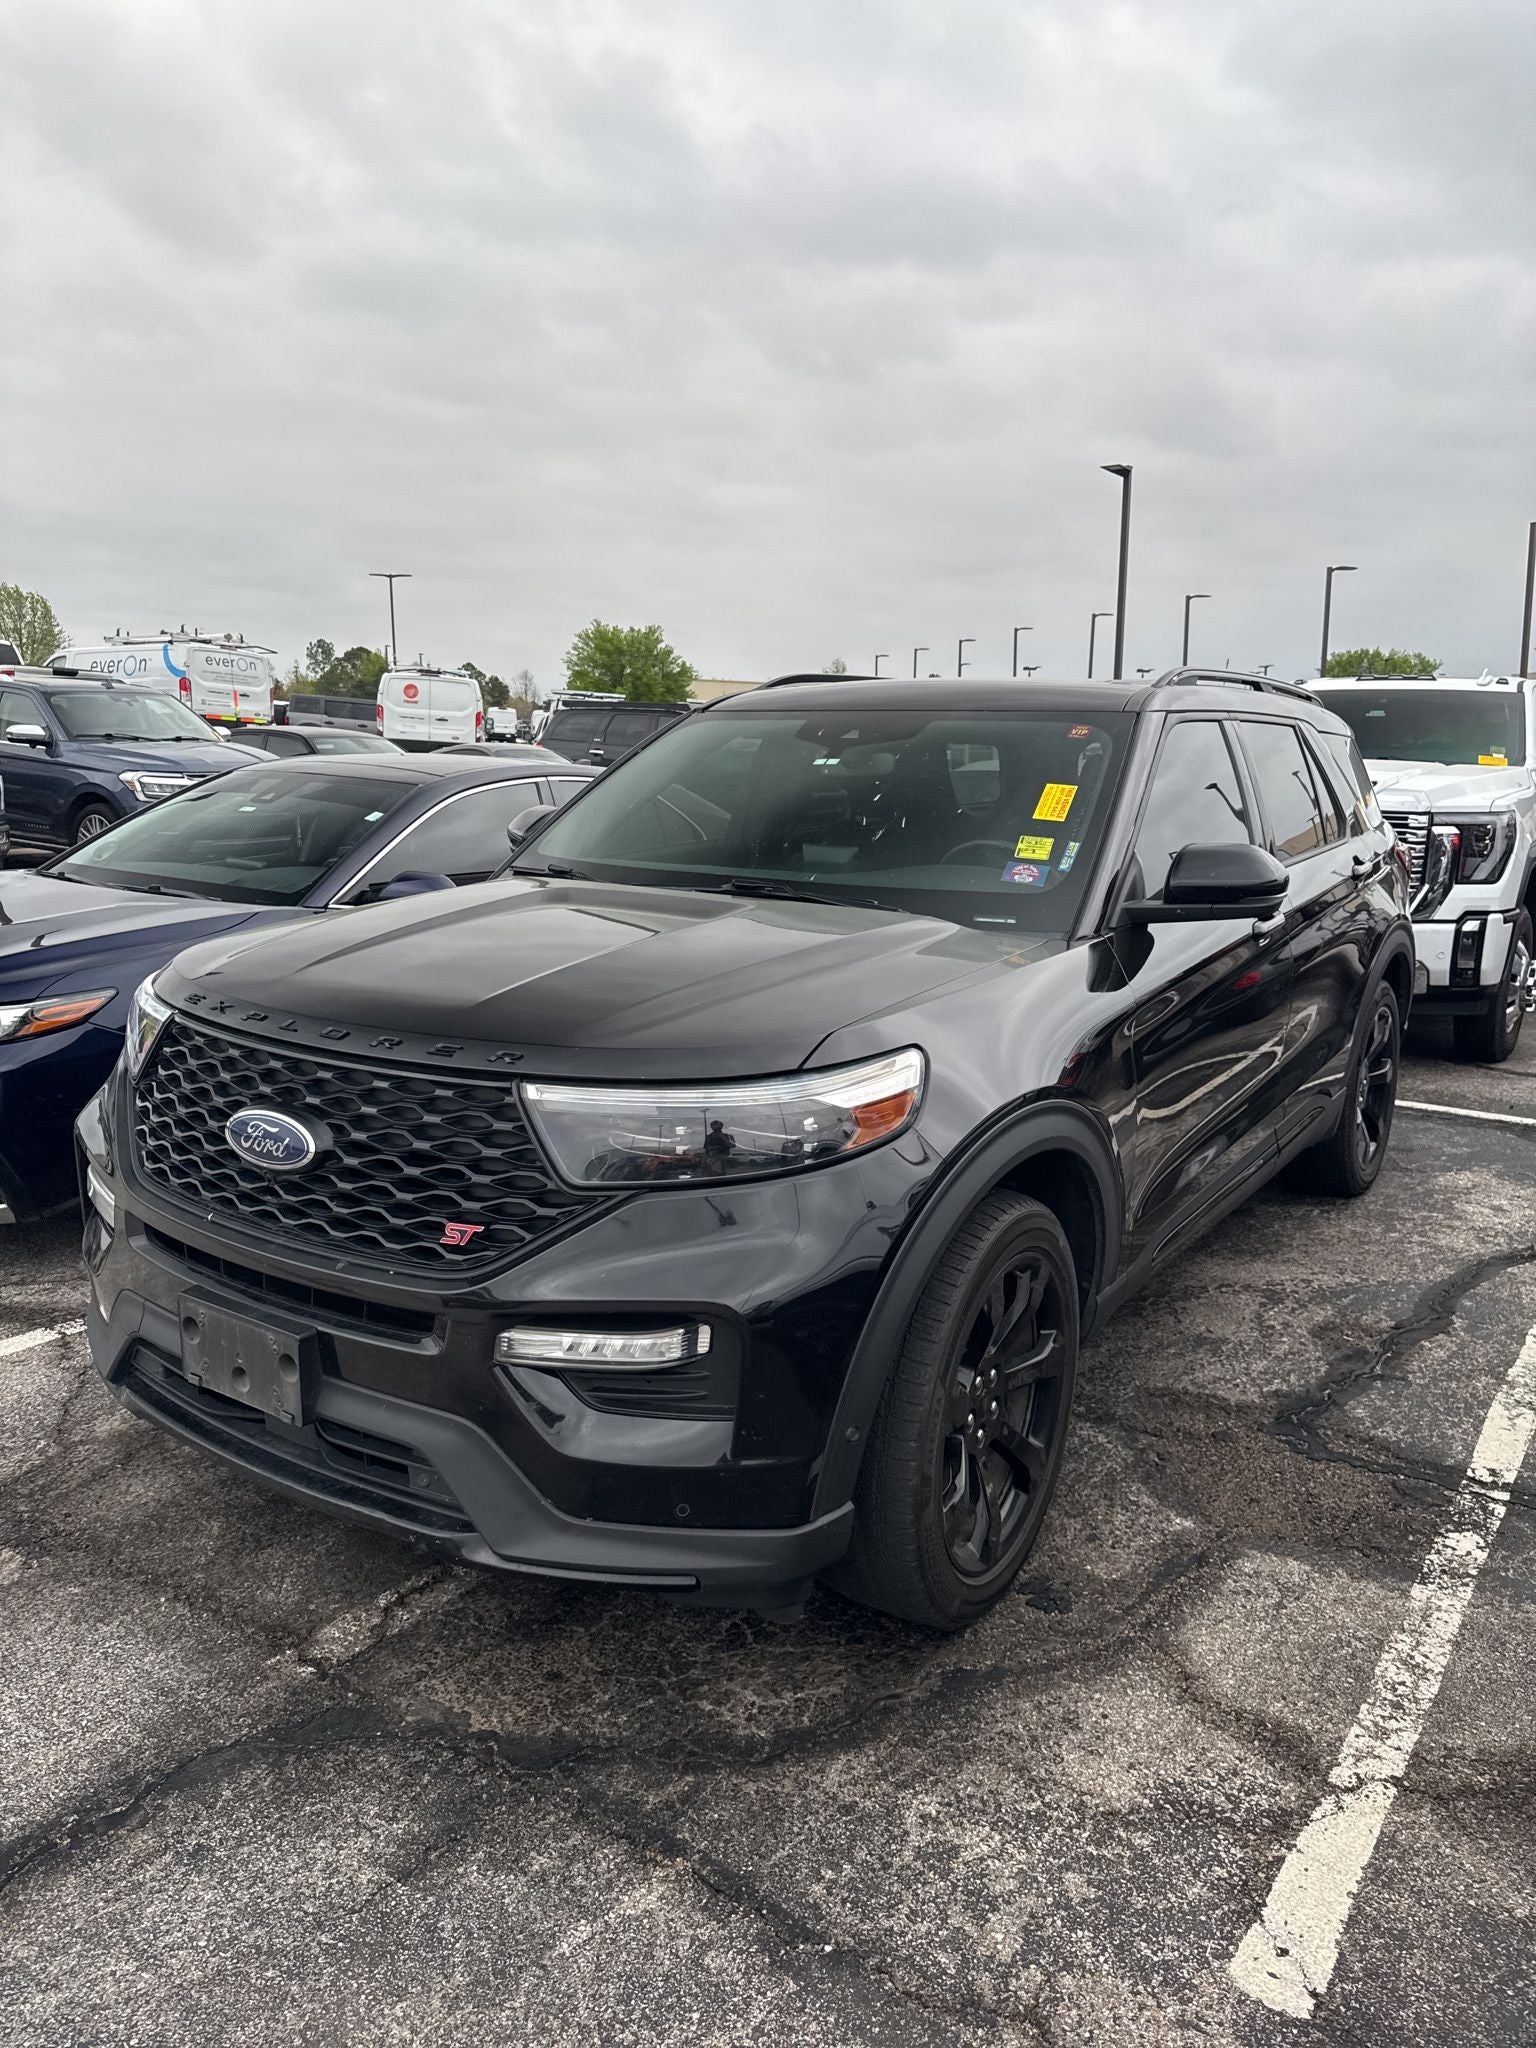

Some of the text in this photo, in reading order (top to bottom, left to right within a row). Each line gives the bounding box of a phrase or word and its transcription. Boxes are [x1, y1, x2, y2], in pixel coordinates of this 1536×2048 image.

[205, 655, 257, 671] everOn
[1072, 728, 1088, 736] VIP
[1055, 798, 1070, 818] VEHICLE
[184, 993, 525, 1065] EXPLORER
[241, 1120, 290, 1158] Ford
[440, 1222, 485, 1245] ST
